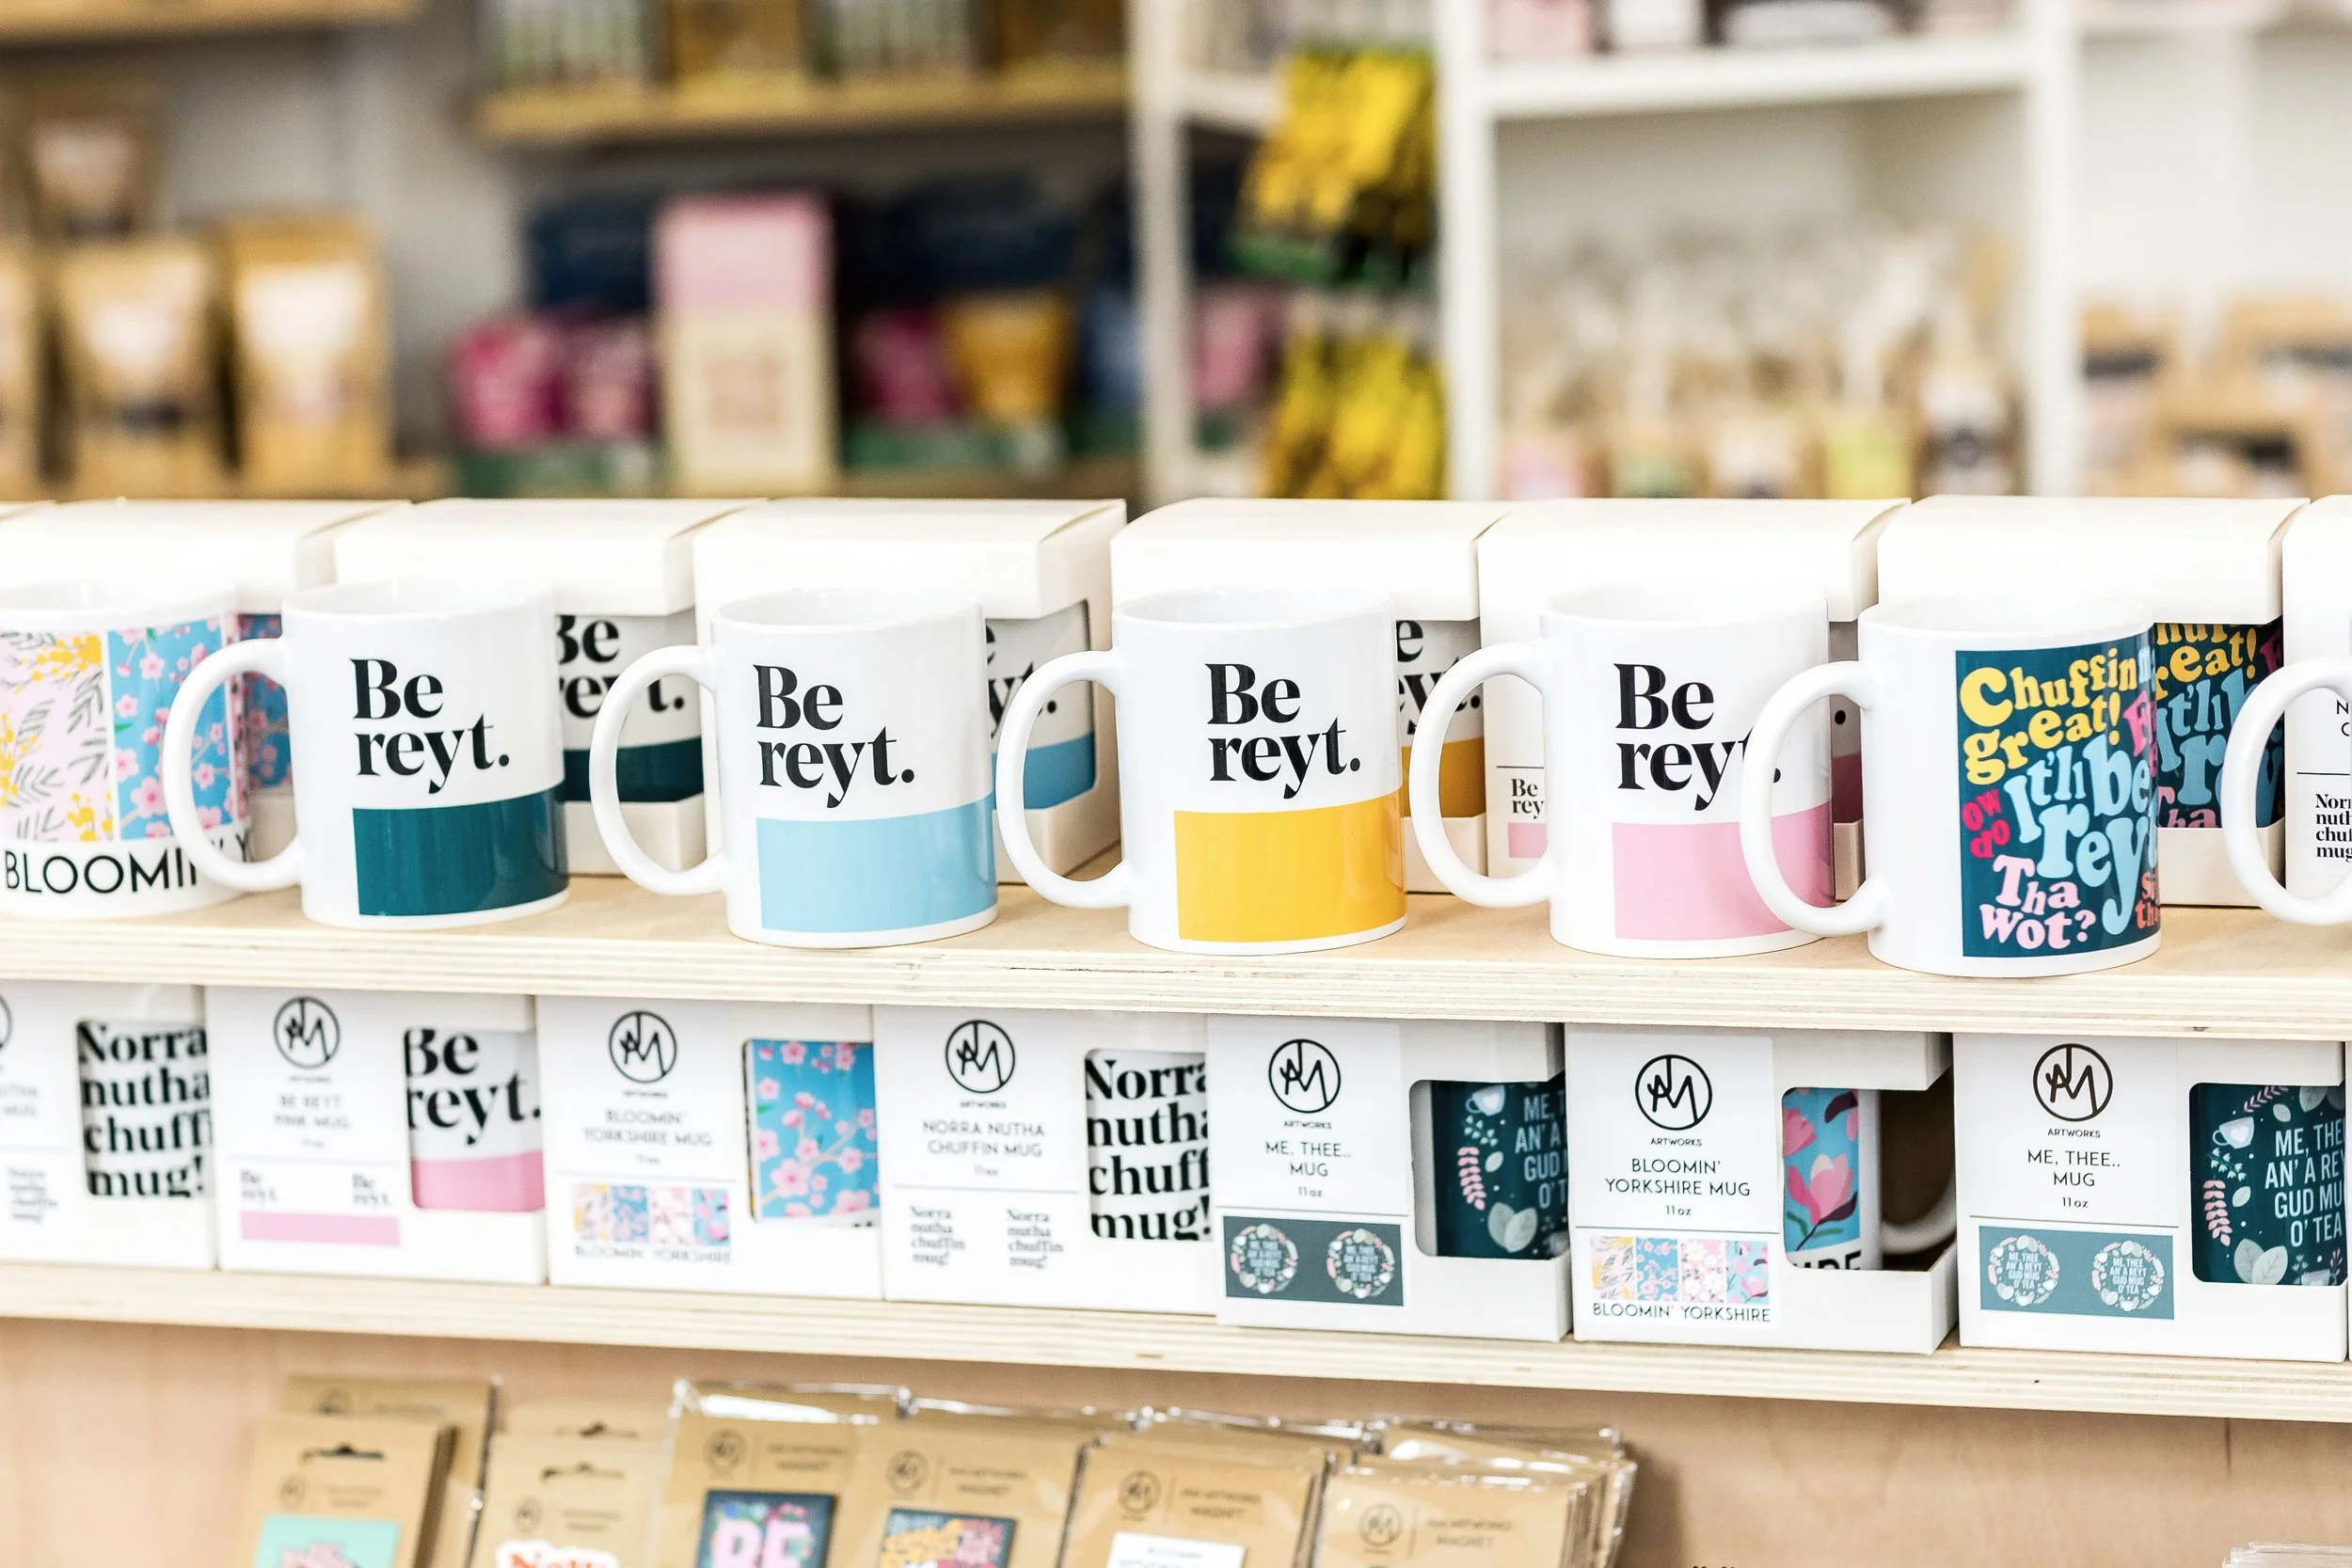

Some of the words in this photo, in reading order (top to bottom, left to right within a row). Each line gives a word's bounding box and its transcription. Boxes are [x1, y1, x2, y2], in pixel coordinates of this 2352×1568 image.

[351, 658, 443, 720] Be
[753, 664, 844, 731] Be
[1205, 663, 1301, 725] Be
[1613, 663, 1715, 730] Be
[1960, 648, 2137, 727] Chuffin
[355, 713, 511, 795] reyt.
[1963, 691, 2122, 785] great!
[757, 726, 915, 809] reyt.
[1208, 717, 1361, 800] reyt.
[2082, 734, 2151, 816] be
[1511, 778, 1538, 798] Be
[1512, 800, 1545, 820] rey
[1993, 854, 2081, 915] Tha
[77, 1020, 208, 1063] Norra
[405, 1070, 542, 1148] reyt.
[922, 1119, 982, 1134] NORRA
[988, 1122, 1045, 1137] NUTHA
[1087, 1101, 1208, 1147] nuth
[928, 1139, 999, 1155] CHUFFIN
[1004, 1143, 1042, 1158] MUG
[1650, 1137, 1703, 1147] ARTWORKS
[2047, 1128, 2101, 1138] ARTWORKS
[2275, 1128, 2310, 1158] ME,
[87, 1155, 203, 1198] mug!
[1290, 1162, 1328, 1178] MUG
[1523, 1150, 1561, 1182] GUD
[1631, 1158, 1722, 1174] BLOOMIN'
[2027, 1148, 2058, 1165] ME,
[2064, 1150, 2121, 1167] THEE..
[2265, 1159, 2298, 1190] AN'
[2304, 1156, 2316, 1184] A
[1605, 1178, 1703, 1195] YORKSHIRE
[1709, 1181, 1751, 1196] MUG
[2053, 1171, 2095, 1187] MUG
[1090, 1195, 1210, 1242] mug!
[2274, 1188, 2314, 1219] GUD
[2319, 1180, 2344, 1212] MU
[2290, 1218, 2308, 1247] O'
[2312, 1212, 2343, 1243] TEA
[1680, 1305, 1772, 1323] YORKSHIRE
